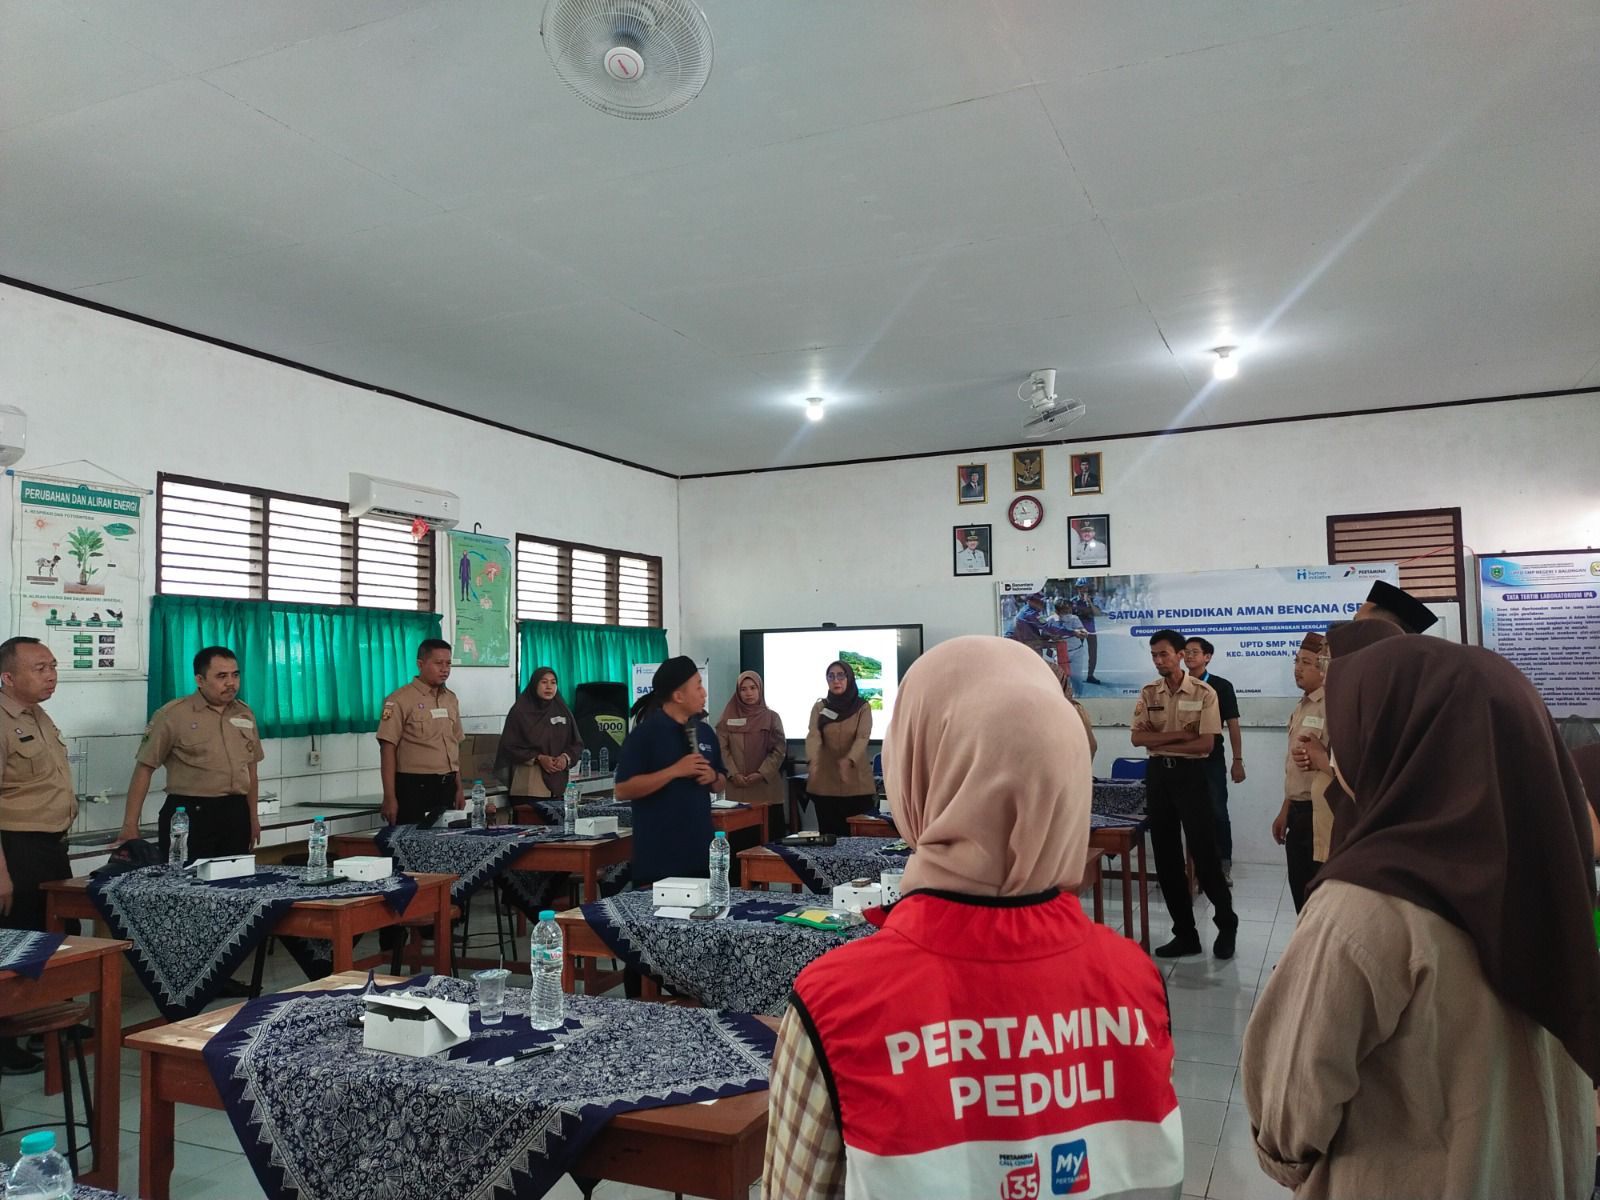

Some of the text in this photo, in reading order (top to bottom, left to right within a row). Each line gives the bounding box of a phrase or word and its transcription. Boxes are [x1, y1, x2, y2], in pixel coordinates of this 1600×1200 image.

[25, 487, 138, 513] PERUBAHAN DAN ALIRAN ENERGI
[1108, 609, 1153, 620] SATUAN
[1157, 606, 1233, 619] PENDIDIKAN
[1236, 605, 1274, 616] AMAN
[1277, 603, 1339, 615] BENCANA
[1240, 640, 1264, 648] UPTD
[1266, 640, 1286, 648] SMP
[599, 722, 623, 731] 1000
[949, 1060, 1115, 1120] PEDULI
[1055, 1151, 1085, 1176] My
